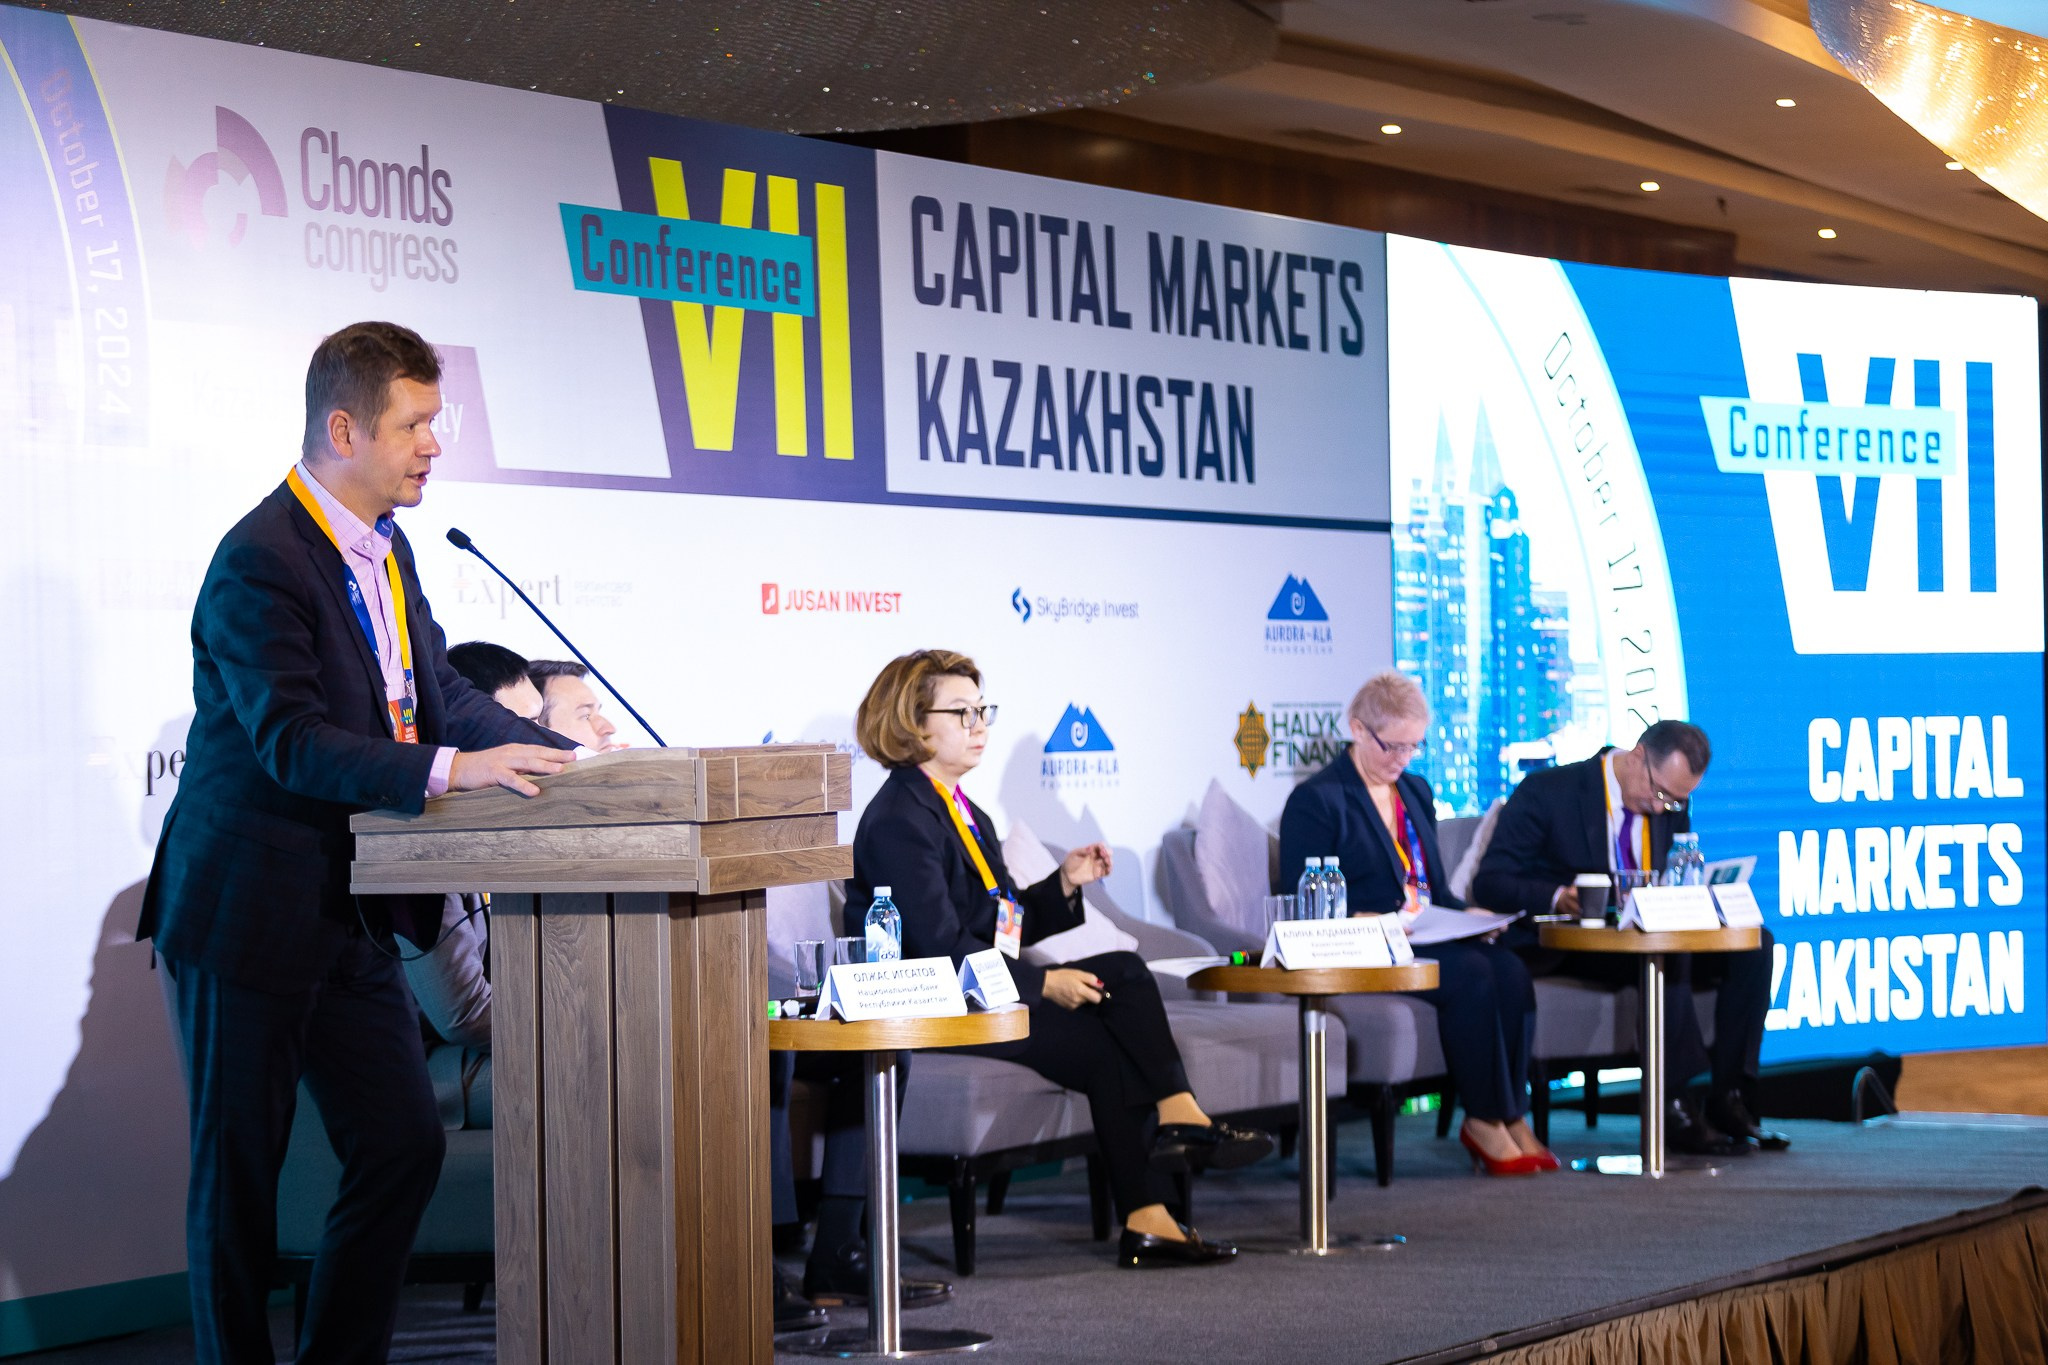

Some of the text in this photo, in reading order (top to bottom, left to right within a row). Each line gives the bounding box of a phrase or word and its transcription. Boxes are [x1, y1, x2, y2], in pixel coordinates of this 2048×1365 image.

[300, 127, 454, 227] Cbonds
[41, 68, 133, 415] October 17, 2024
[304, 221, 459, 292] congress
[580, 213, 802, 306] Conference
[911, 195, 1365, 357] CAPITAL MARKETS
[648, 156, 855, 461] VII
[915, 351, 1256, 485] KAZAKHSTAN
[1728, 405, 1942, 464] Conference
[1796, 352, 1998, 593] VII
[1544, 332, 1618, 526] October
[1621, 629, 1660, 736] 202
[454, 563, 565, 620] Expert
[784, 589, 902, 613] JUSAN INVEST
[1037, 596, 1101, 624] SkyBridge
[1265, 625, 1333, 642] AURORA-ALA
[1042, 758, 1119, 776] AURORA-ALA
[1272, 712, 1342, 737] HALYK
[1272, 741, 1354, 767] FINAN
[1808, 715, 2025, 804] CAPITAL
[1778, 822, 2024, 917] MARKETS
[853, 967, 936, 983] ОЛЖАС ИГСАТОВ
[1765, 930, 2025, 1032] ZAKHSTAN
